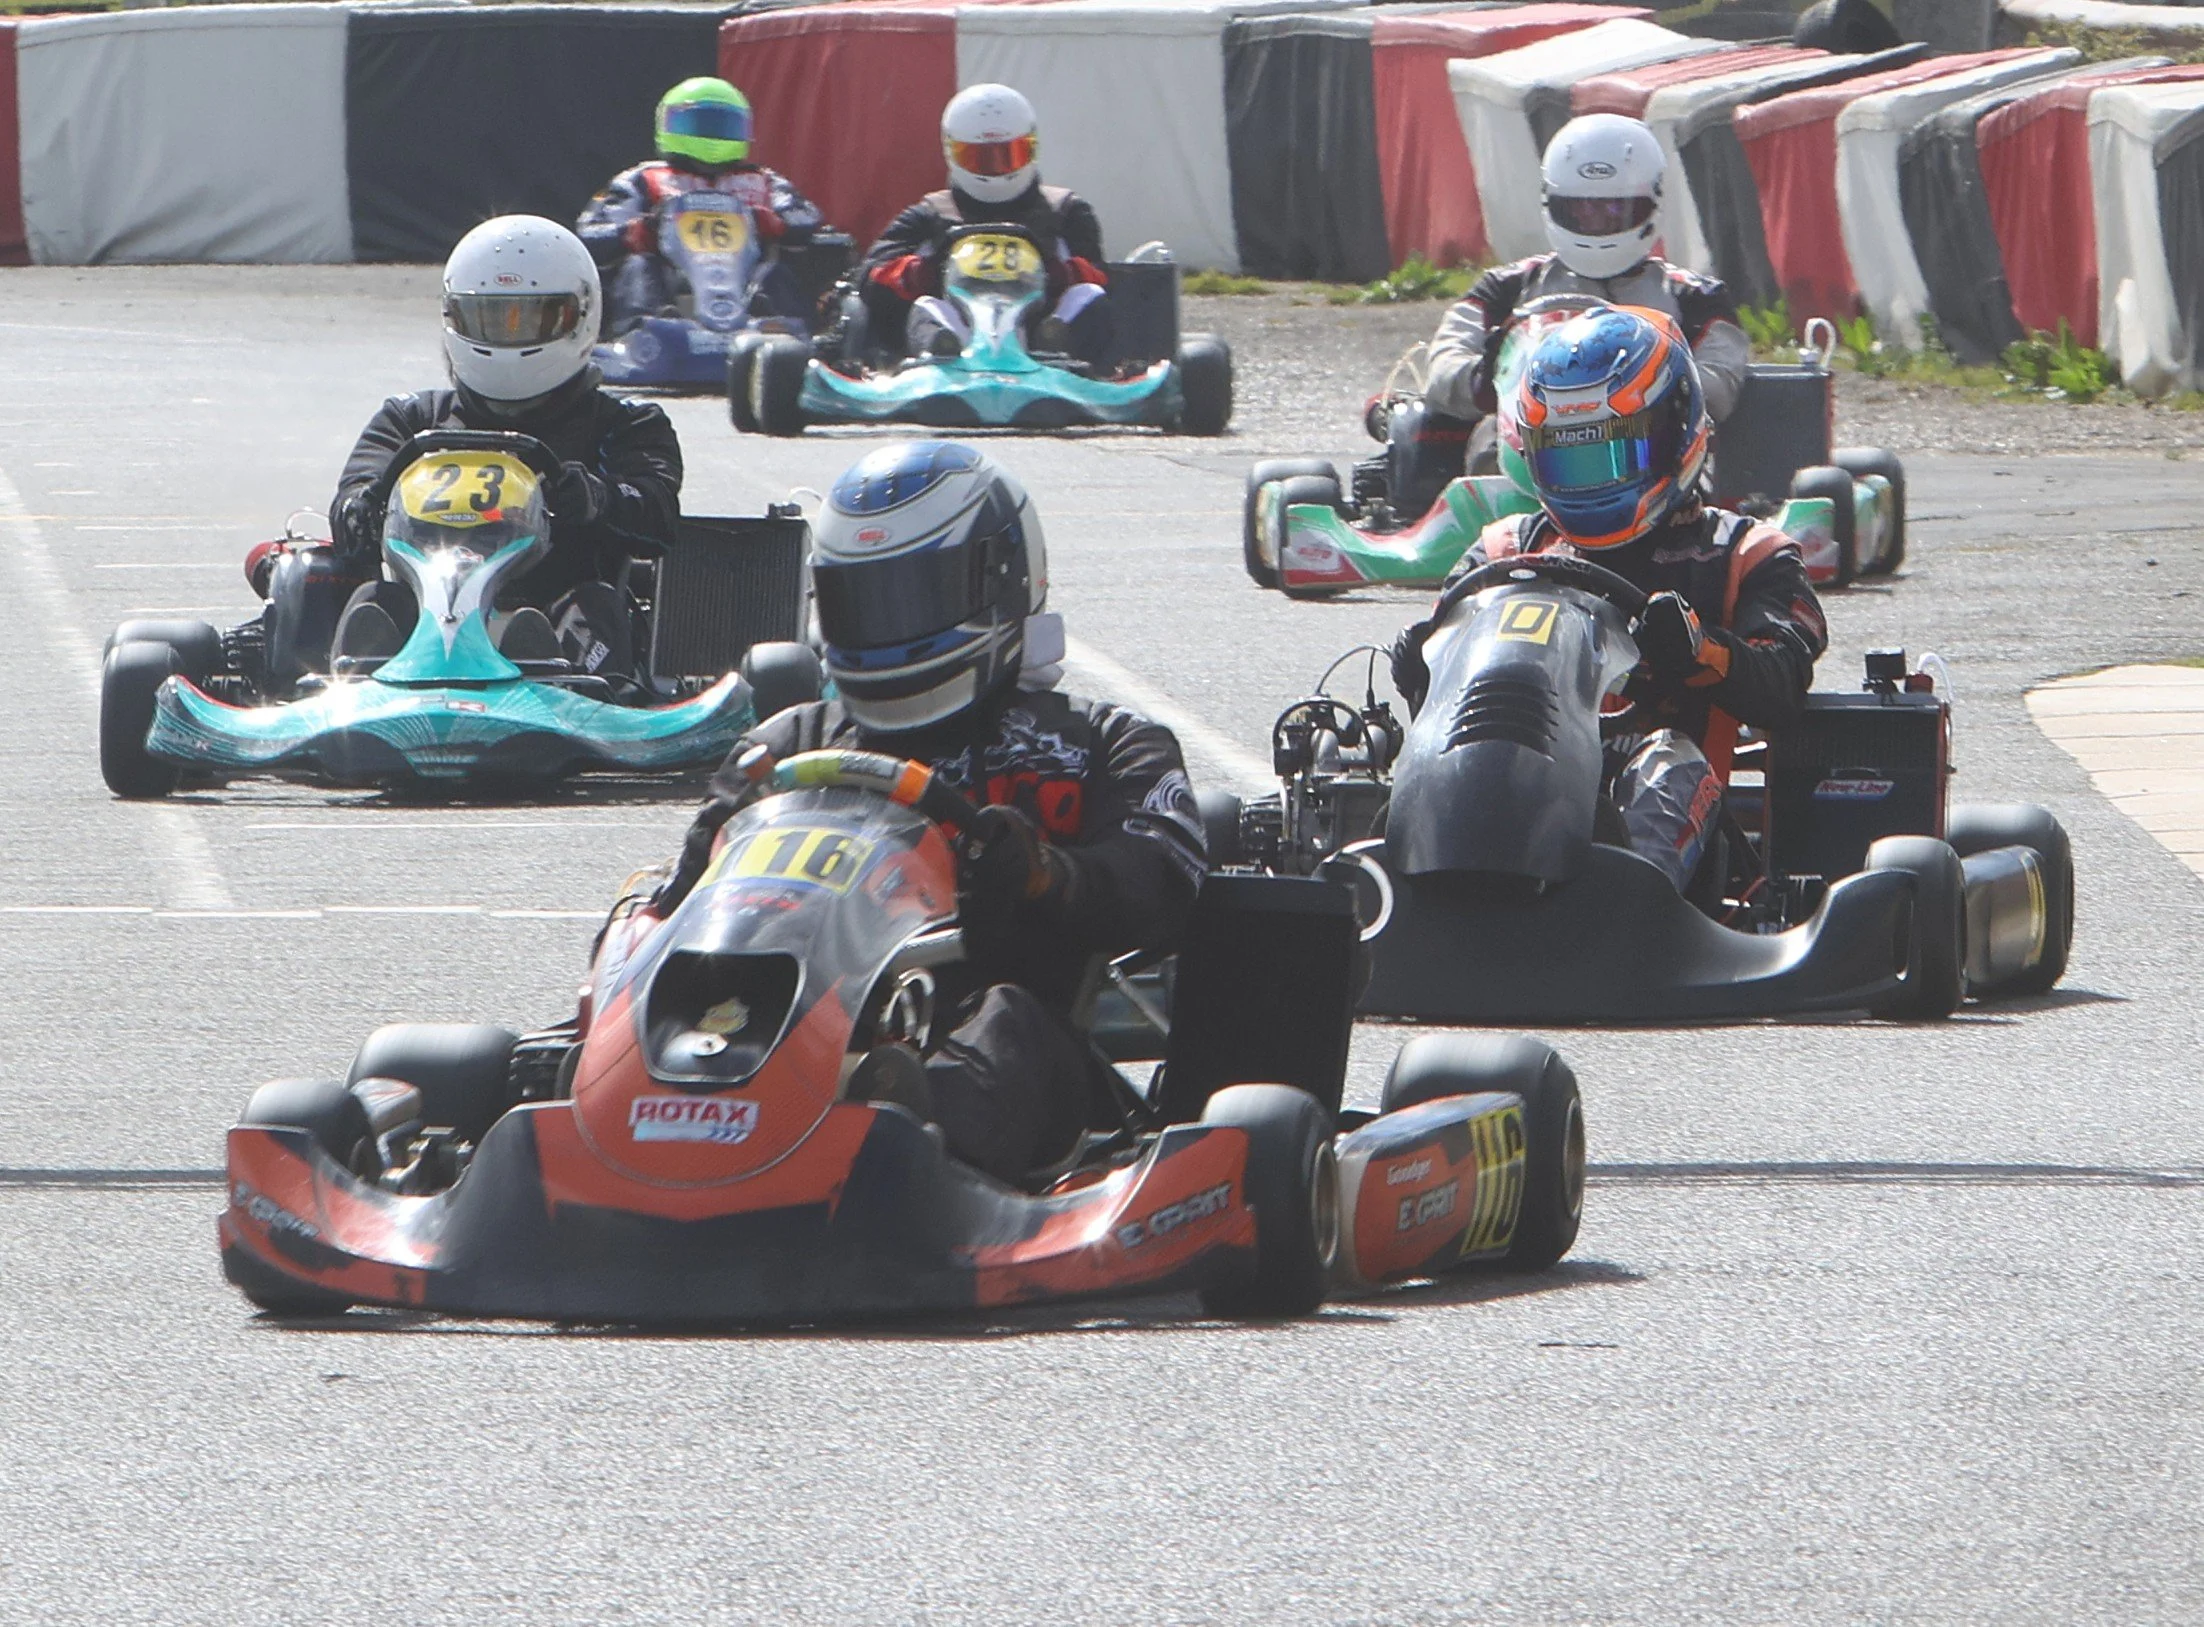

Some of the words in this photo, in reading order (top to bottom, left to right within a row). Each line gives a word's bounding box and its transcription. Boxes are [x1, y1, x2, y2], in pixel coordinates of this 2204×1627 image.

[688, 219, 734, 250] 16
[977, 240, 1019, 271] 28
[420, 463, 506, 514] 23
[636, 1101, 750, 1124] ROTAX
